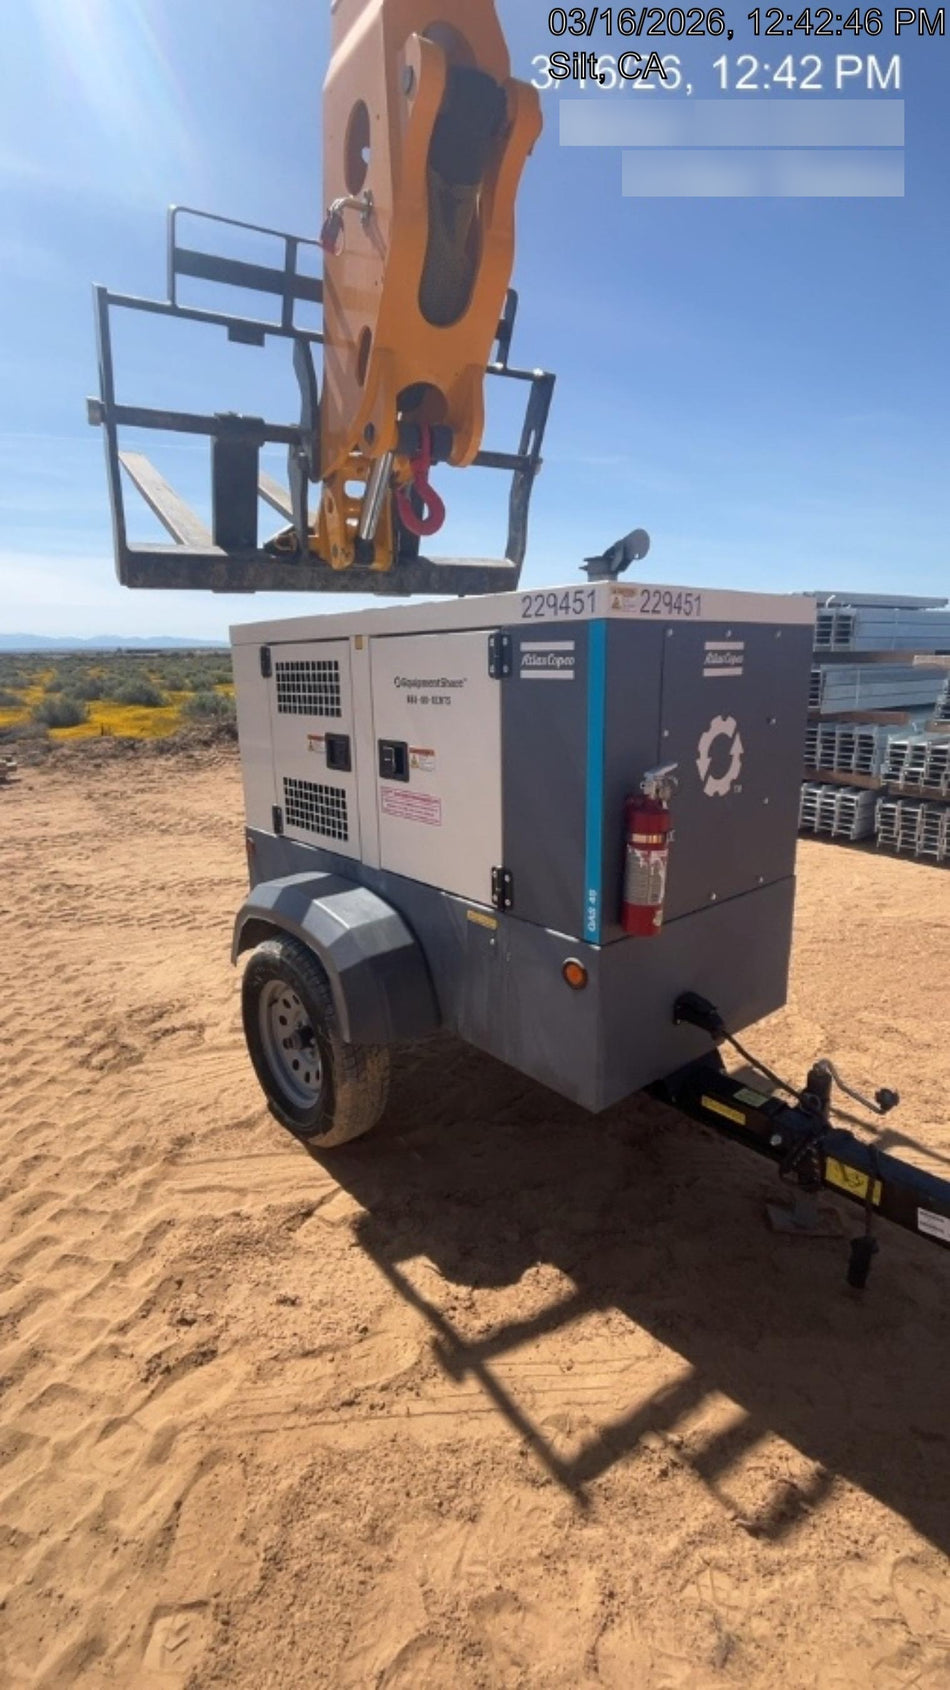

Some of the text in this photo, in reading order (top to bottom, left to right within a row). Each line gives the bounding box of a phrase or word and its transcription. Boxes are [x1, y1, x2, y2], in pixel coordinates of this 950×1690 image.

[521, 587, 597, 618] 229451
[639, 588, 702, 617] 229451
[520, 652, 576, 670] Atlas Copco
